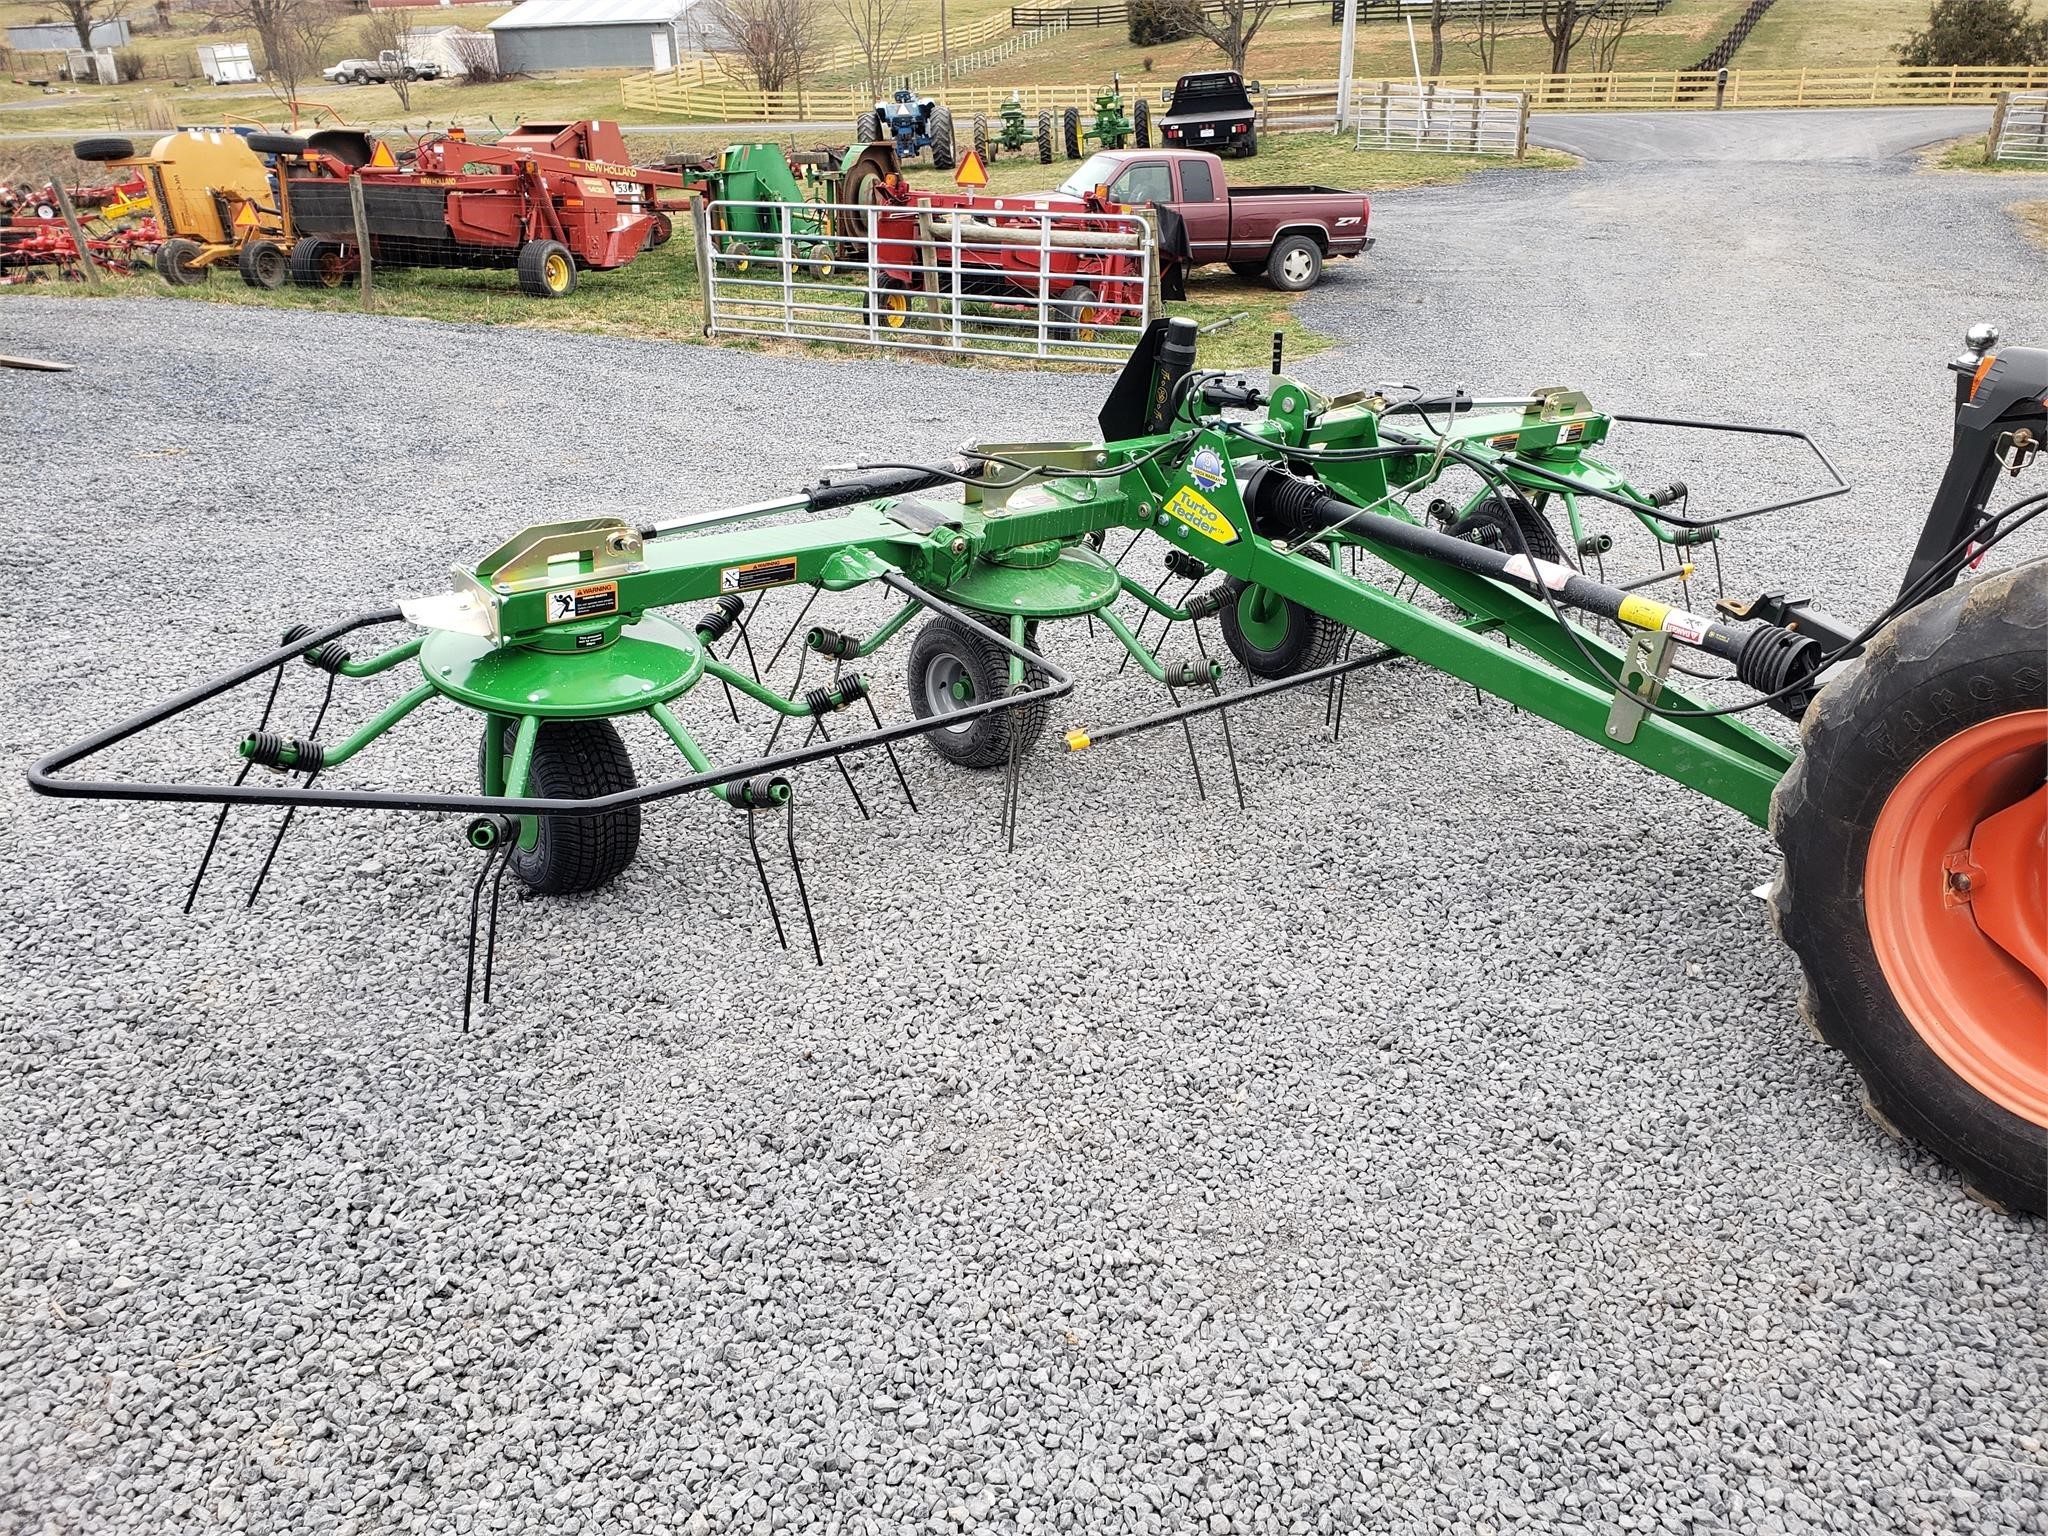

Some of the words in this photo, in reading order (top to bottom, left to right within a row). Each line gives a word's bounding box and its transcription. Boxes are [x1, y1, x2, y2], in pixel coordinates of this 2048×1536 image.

[585, 162, 602, 172] NEW
[603, 165, 637, 177] HOLLAND
[432, 176, 456, 186] HOLLAND
[1335, 216, 1362, 227] Z71
[1180, 491, 1217, 521] Turbo
[583, 585, 612, 594] WARNING
[1667, 623, 1691, 638] DANGER
